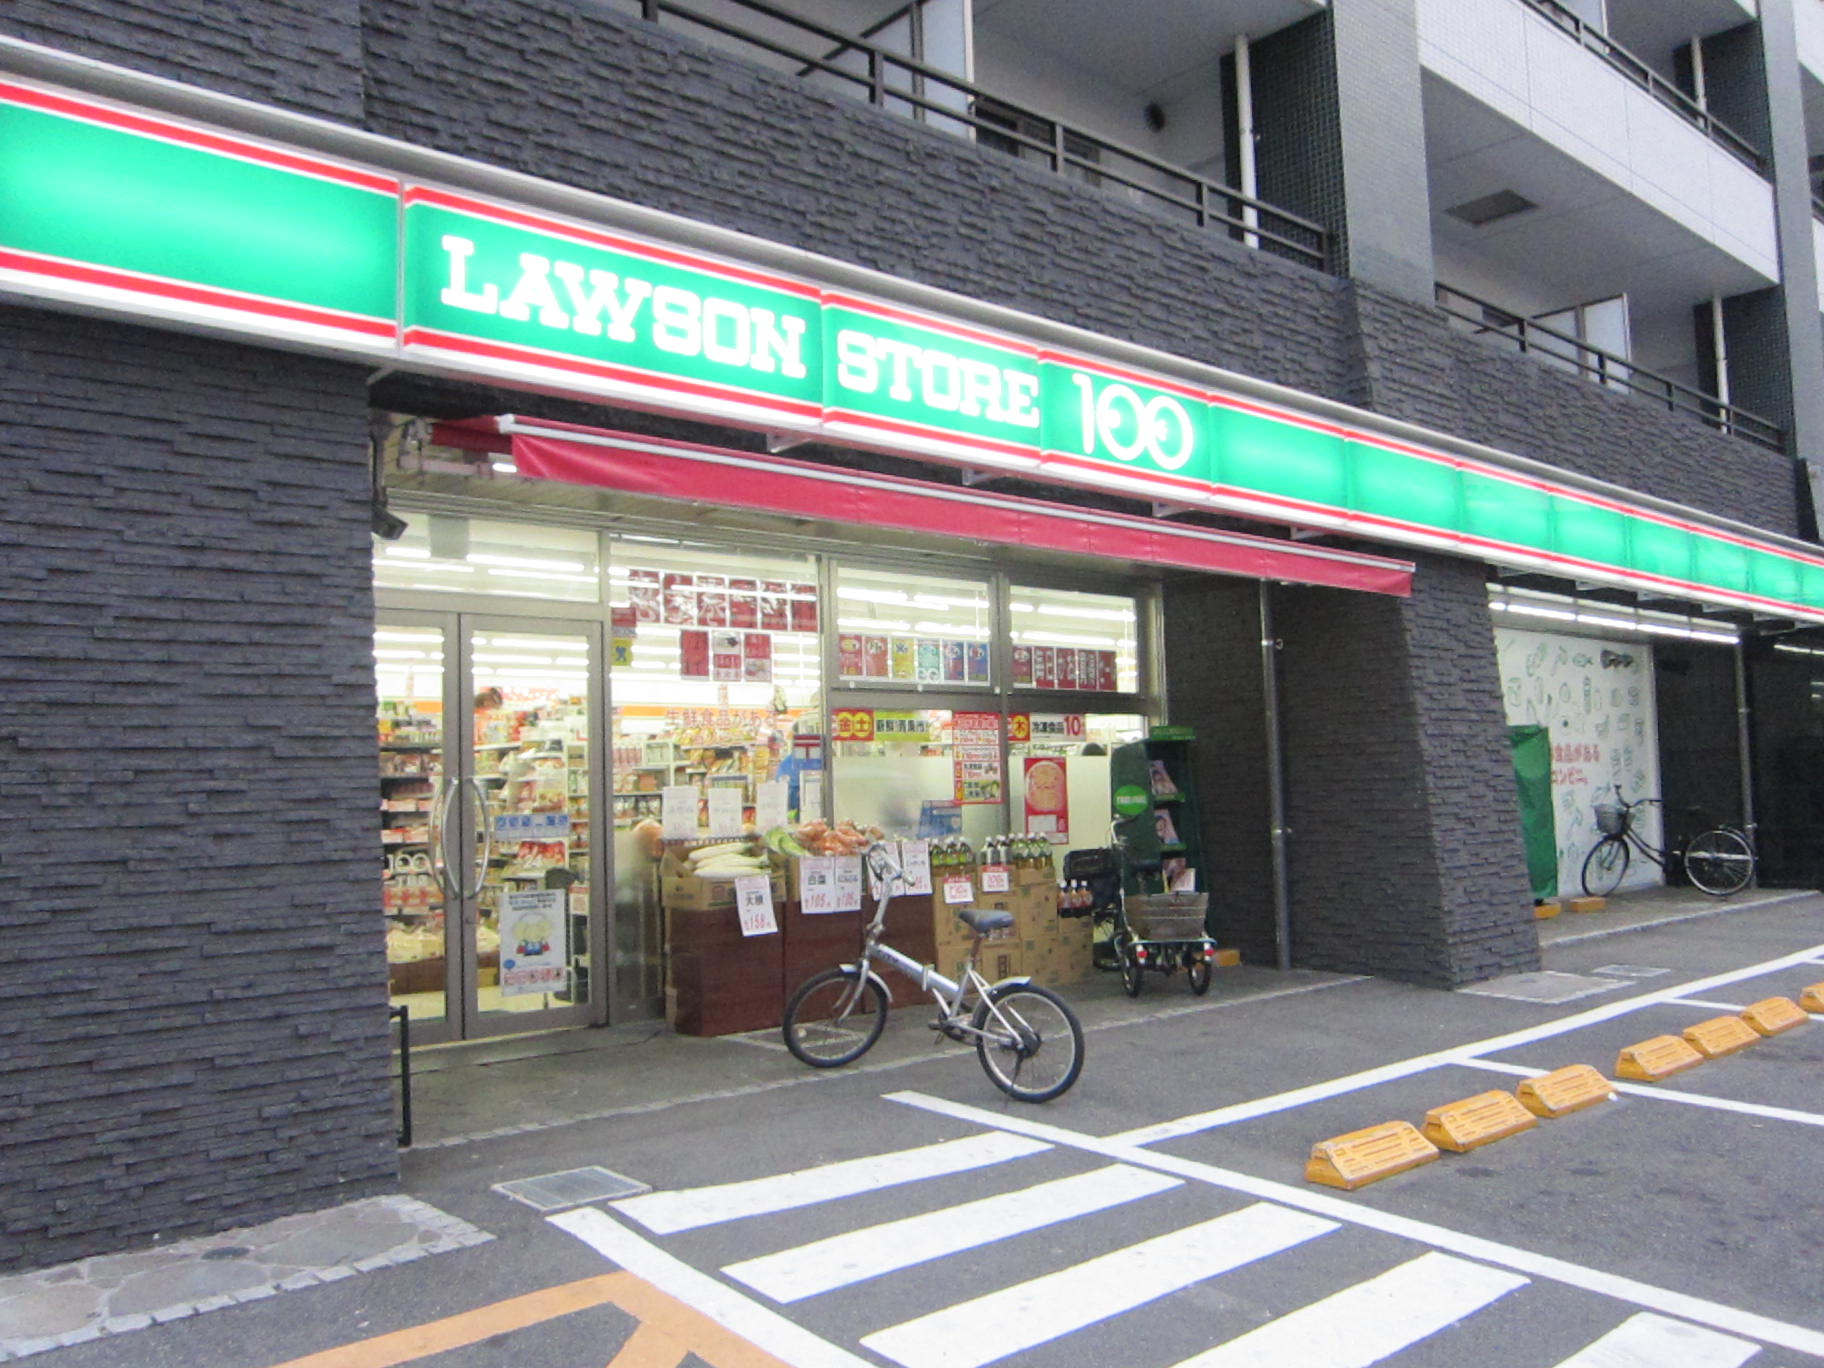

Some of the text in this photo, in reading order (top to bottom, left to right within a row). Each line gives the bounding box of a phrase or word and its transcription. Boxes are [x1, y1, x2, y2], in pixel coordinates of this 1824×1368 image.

[440, 235, 1194, 471] LAWSON STORE 100
[1553, 743, 1601, 763] 食品がある
